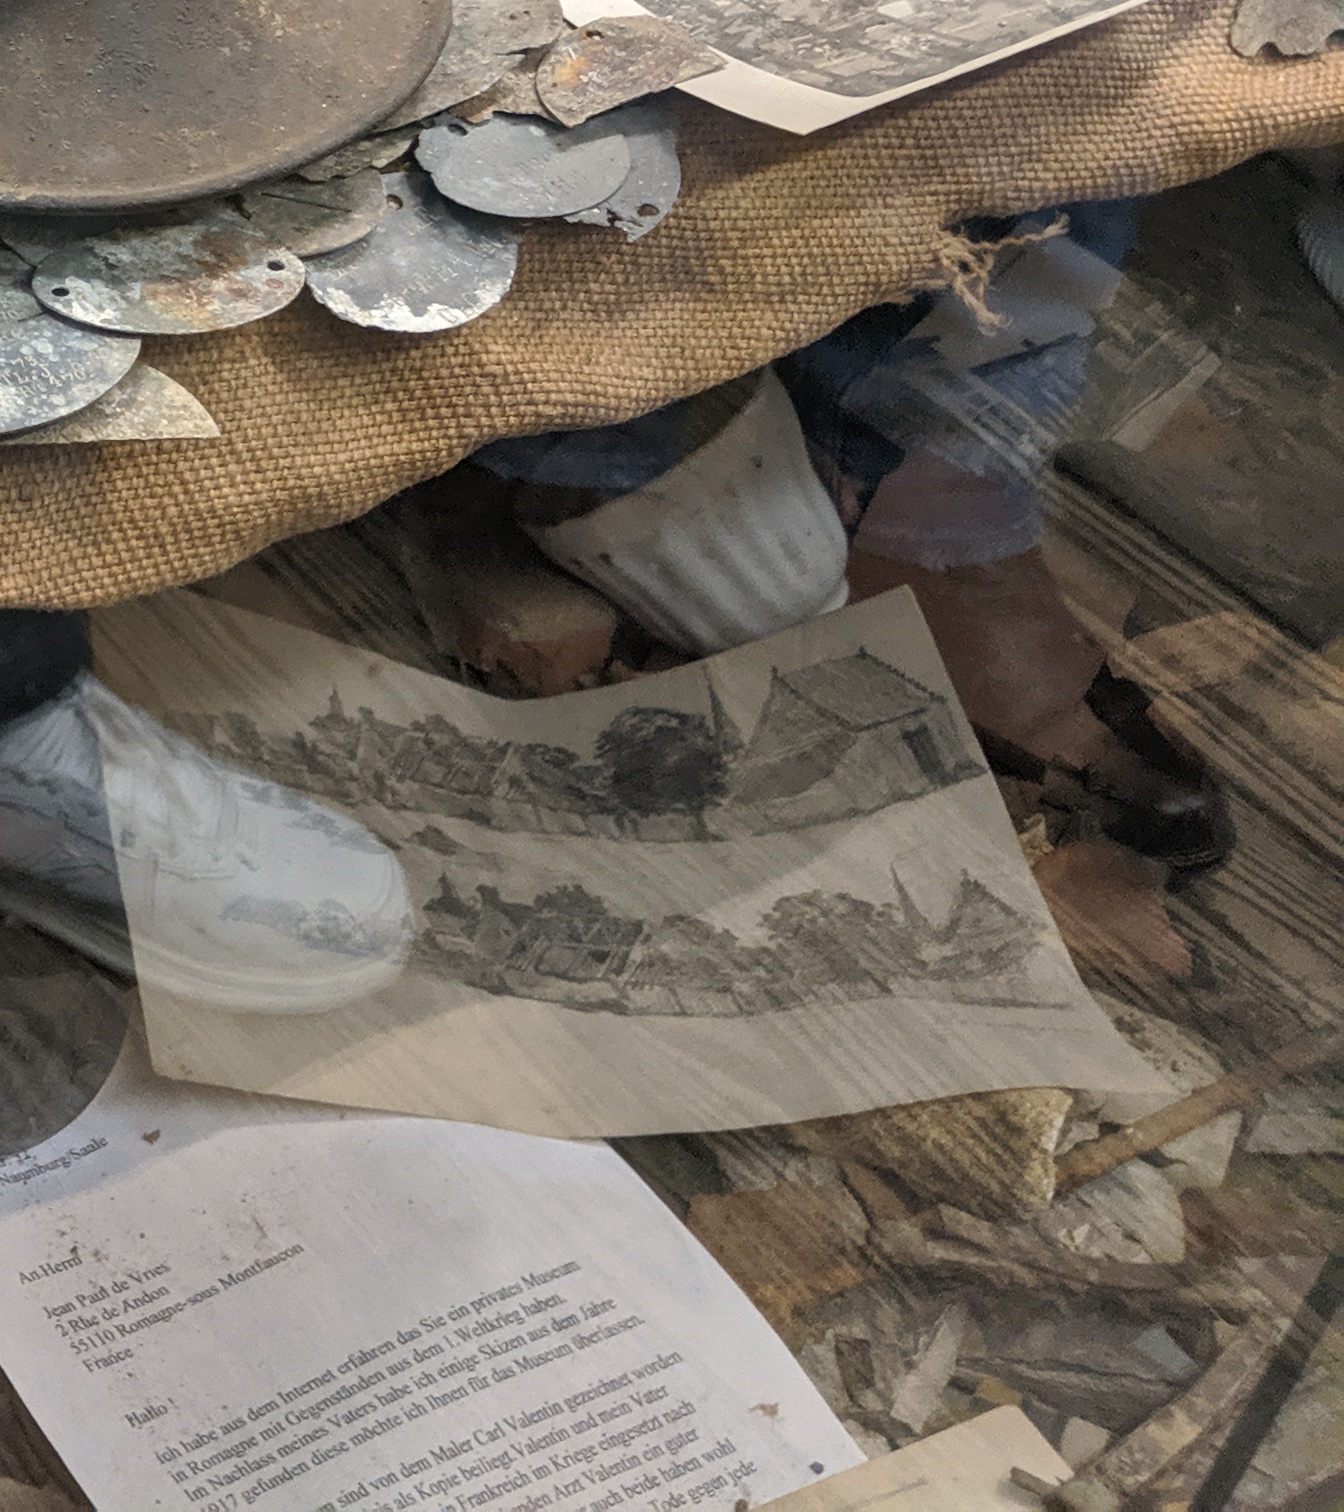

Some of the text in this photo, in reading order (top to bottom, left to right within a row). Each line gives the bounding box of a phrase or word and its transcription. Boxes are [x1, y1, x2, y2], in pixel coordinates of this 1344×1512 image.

[41, 1259, 173, 1320] Jean Paul de Vries
[69, 1243, 305, 1356] 55110 Romagne-sous Montfaucon
[101, 1307, 121, 1321] de
[121, 1286, 171, 1314] Andon
[81, 1347, 135, 1374] France
[123, 1404, 169, 1430] Hallo
[153, 1260, 582, 1466] Ich habe aus dem Internet erfahren das Sie ein privates Museum
[167, 1469, 190, 1485] in
[185, 1435, 260, 1476] Romagne
[258, 1421, 287, 1442] mit
[284, 1370, 388, 1427] Gegenständen
[385, 1357, 414, 1377] aus
[412, 1342, 446, 1364] dem
[182, 1298, 617, 1503] Im Nachlass meines Vaters habe ich einige Skizen aus dem Jahre
[240, 1461, 312, 1506] gefunden
[310, 1441, 351, 1467] diese
[348, 1414, 404, 1448] möchte
[400, 1401, 430, 1422] ich
[424, 1385, 470, 1411] Ihnen
[466, 1375, 492, 1394] für
[490, 1365, 518, 1384] das
[512, 1343, 575, 1374] Museum
[336, 1481, 371, 1509] sind
[368, 1471, 401, 1491] von
[399, 1457, 433, 1479] dem
[428, 1438, 475, 1466] Maler
[471, 1420, 507, 1447] Carl
[501, 1400, 565, 1433] Valentin
[562, 1371, 634, 1414] gezeichnet
[630, 1351, 685, 1380] worden
[392, 1491, 418, 1511] als
[412, 1472, 463, 1501] Kopie
[569, 1411, 600, 1436] und
[596, 1400, 634, 1425] mein
[627, 1384, 670, 1408] Vater
[454, 1469, 533, 1512] Frankreich
[528, 1464, 553, 1481] im
[547, 1444, 600, 1473] Kriege
[597, 1414, 665, 1452] eingesetzt
[661, 1399, 697, 1425] nach
[552, 1427, 700, 1502] Arzt Valentin ein guter
[619, 1473, 662, 1500] beide
[656, 1456, 704, 1484] haben
[700, 1436, 738, 1463] wohl
[687, 1474, 729, 1506] gegen
[723, 1459, 758, 1488] jede
